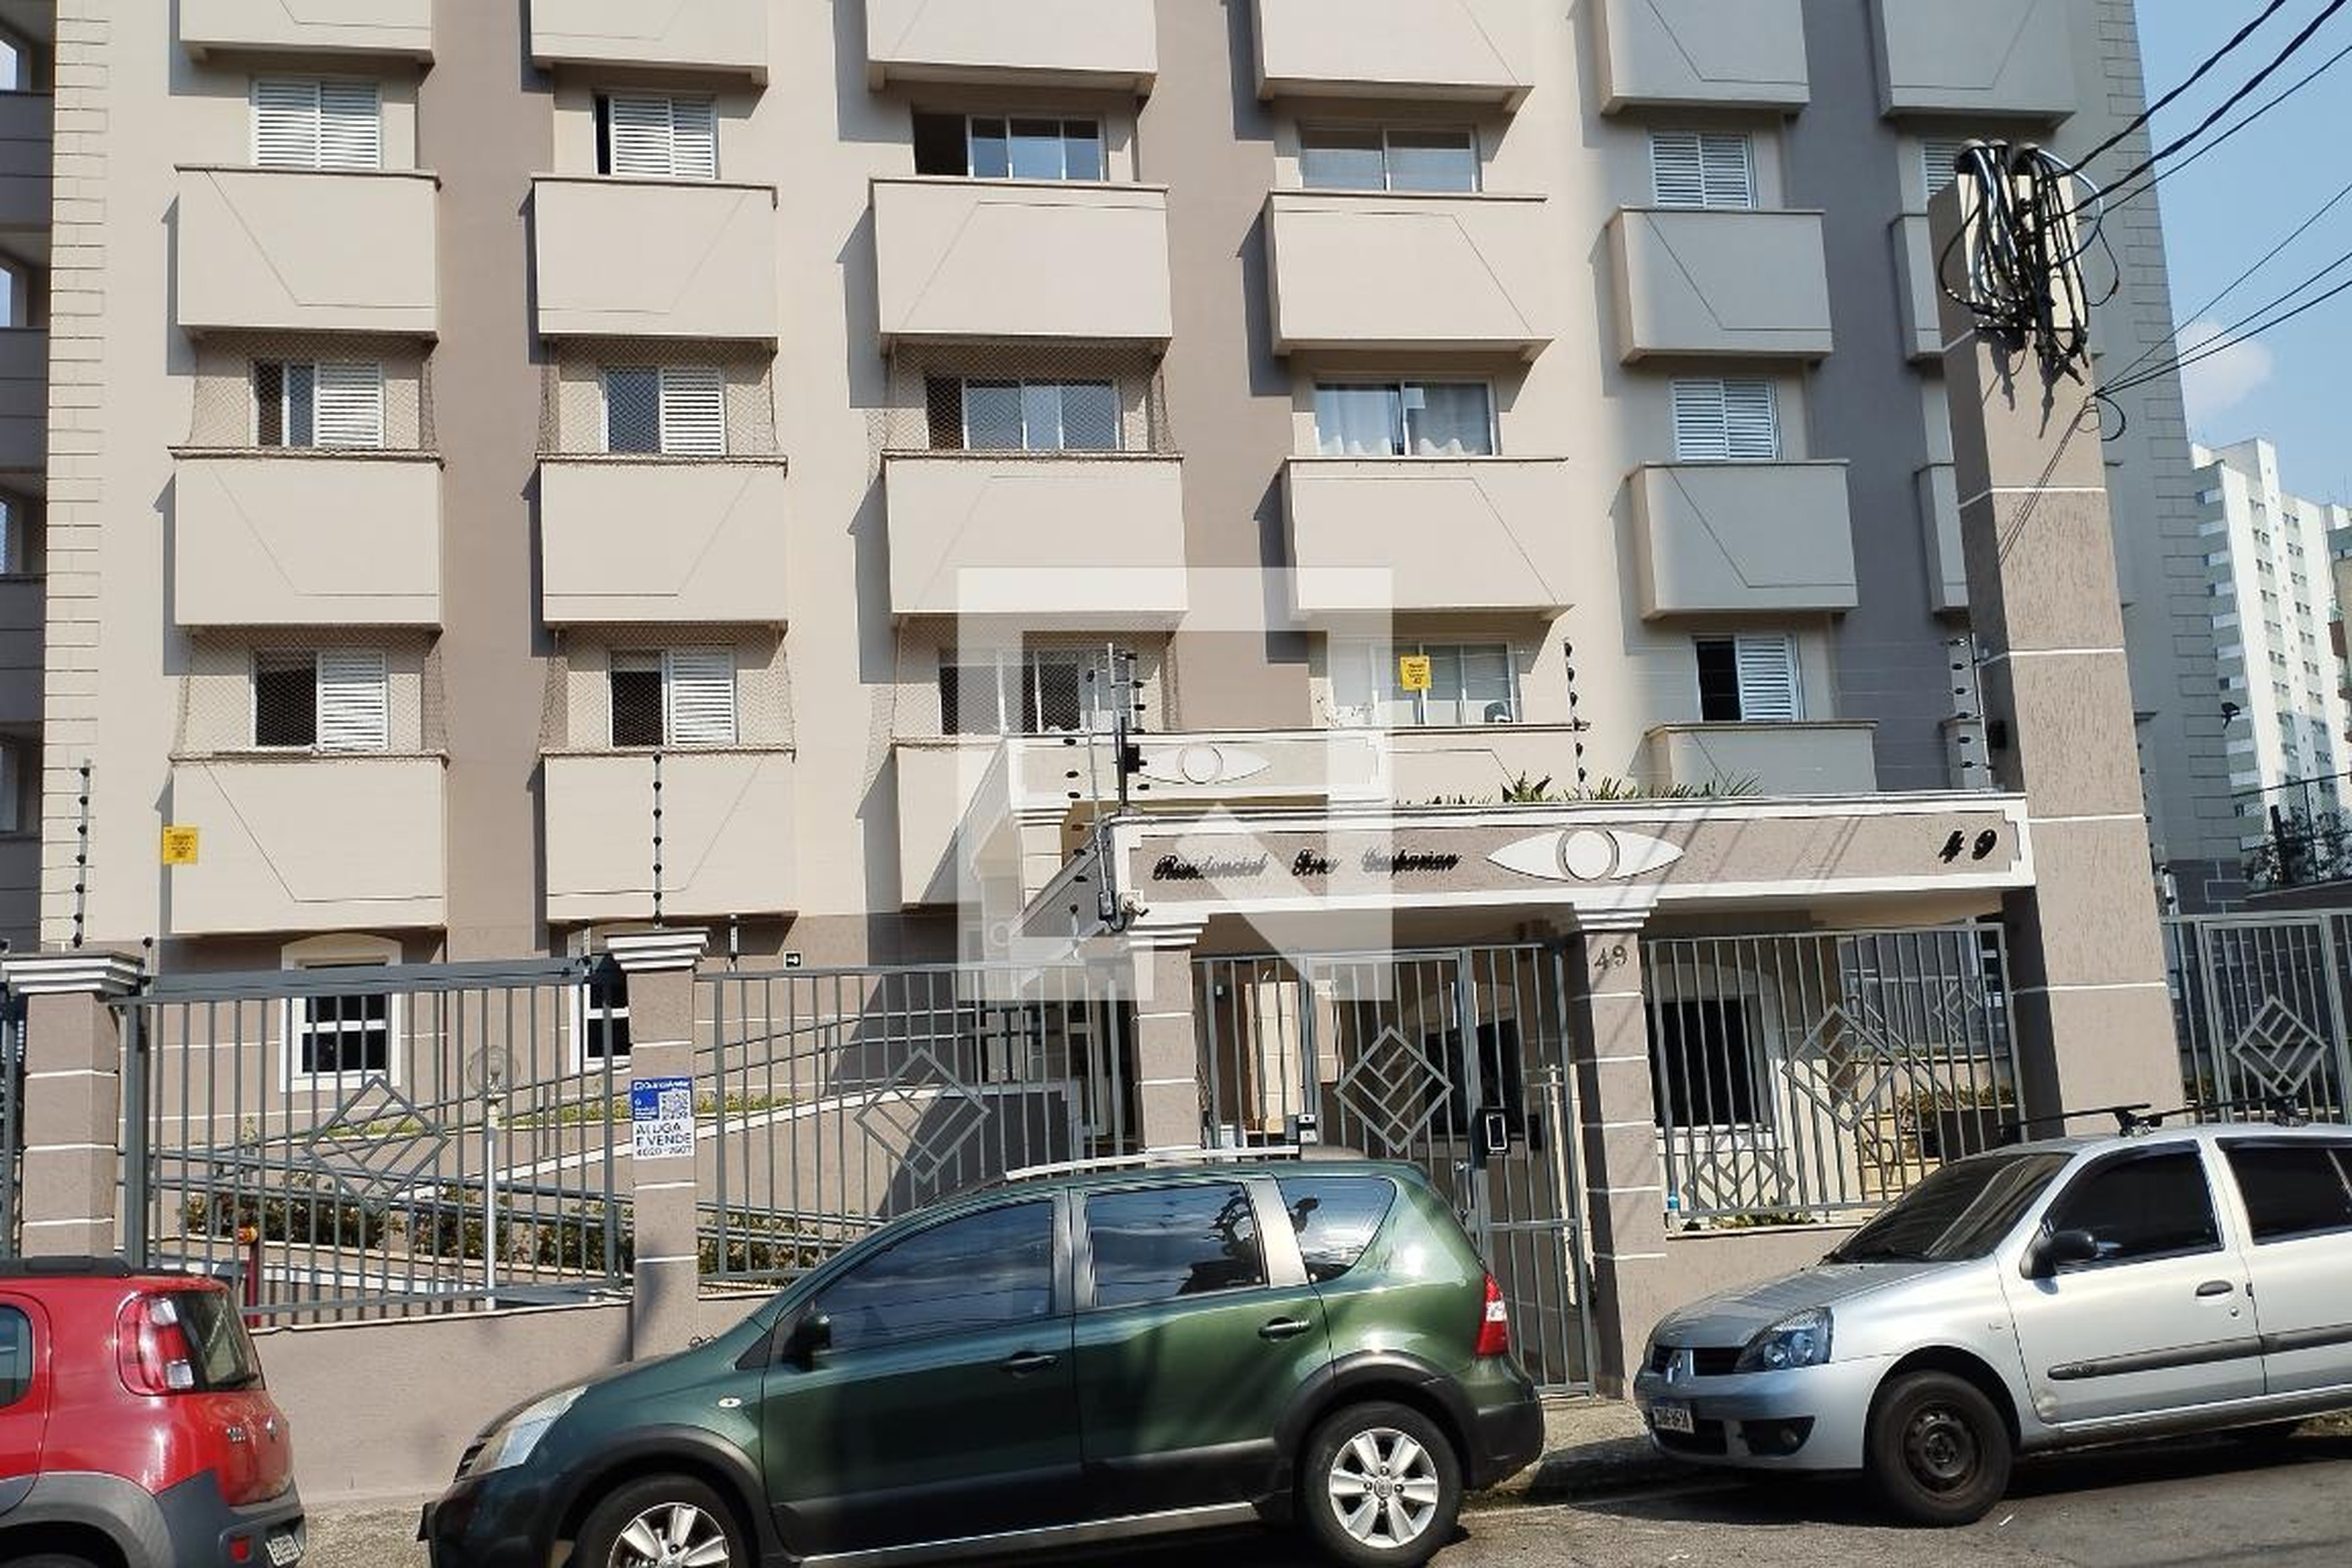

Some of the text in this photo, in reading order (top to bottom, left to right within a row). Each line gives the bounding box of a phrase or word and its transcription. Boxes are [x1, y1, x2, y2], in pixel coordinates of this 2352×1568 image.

[1938, 829, 1997, 864] 49
[1594, 944, 1627, 970] 49
[647, 1133, 692, 1146] VENDE
